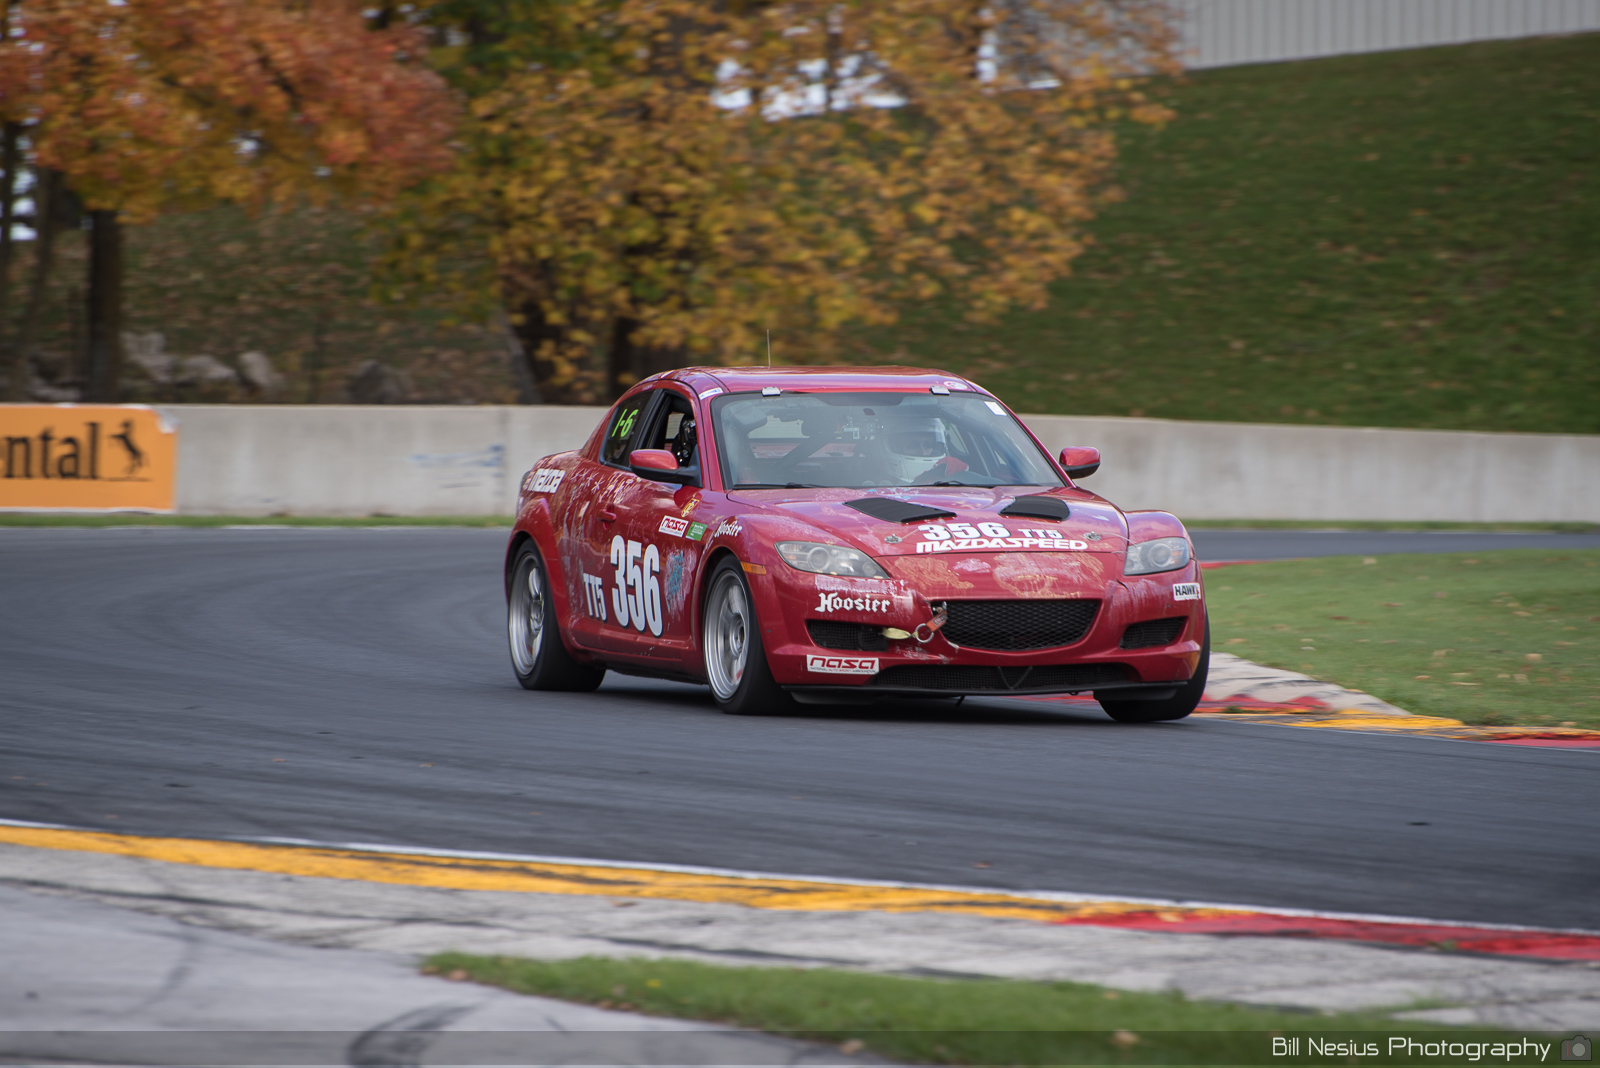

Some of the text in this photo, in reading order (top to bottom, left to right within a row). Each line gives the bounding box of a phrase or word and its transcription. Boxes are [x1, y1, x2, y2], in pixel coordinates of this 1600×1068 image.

[0, 421, 101, 480] ntal
[917, 522, 1064, 541] 356 TT5
[916, 537, 1088, 553] MAZDASPEED
[583, 535, 663, 637] TT5 356
[814, 591, 891, 613] Hoosier
